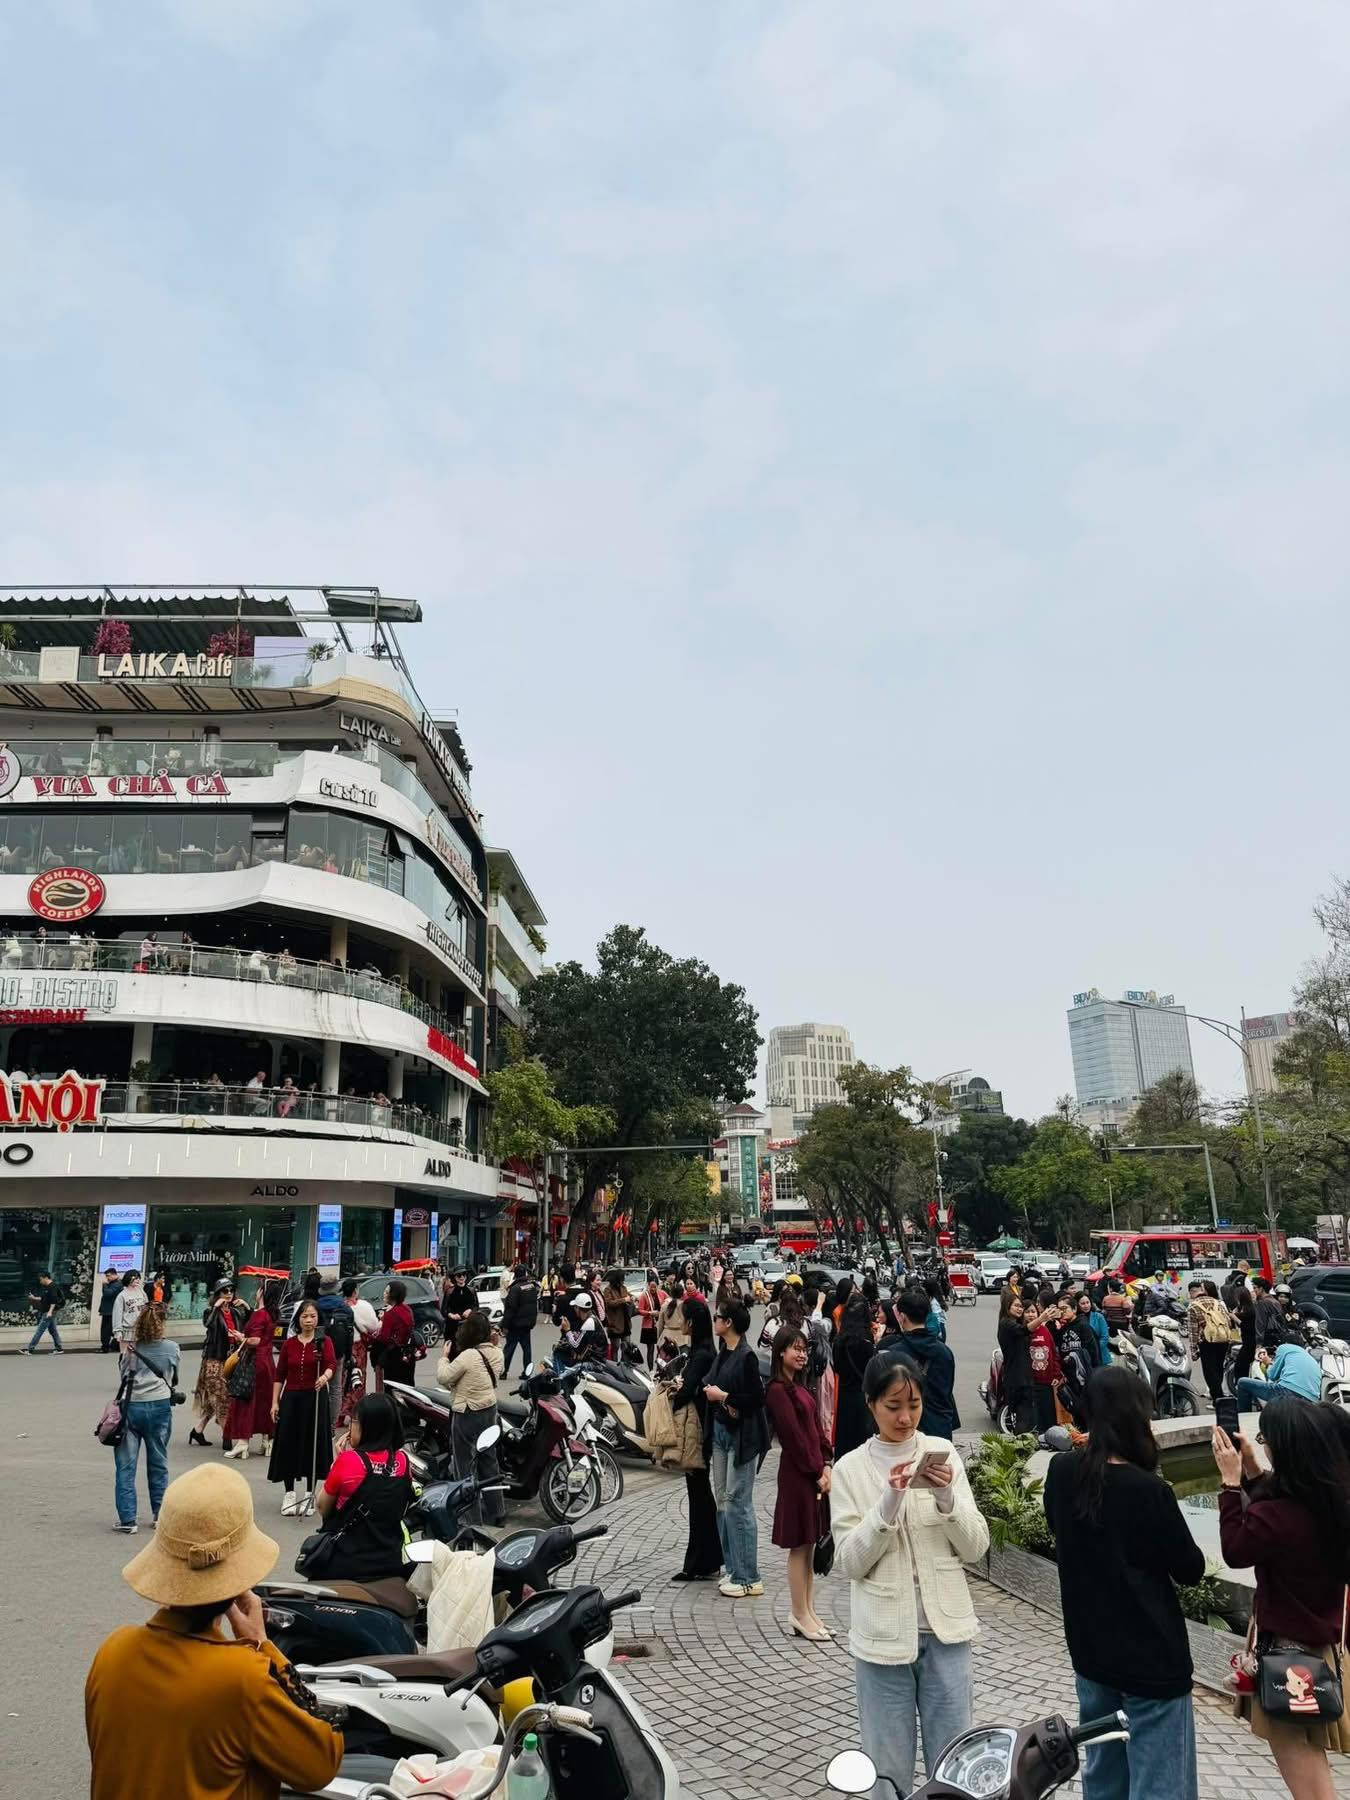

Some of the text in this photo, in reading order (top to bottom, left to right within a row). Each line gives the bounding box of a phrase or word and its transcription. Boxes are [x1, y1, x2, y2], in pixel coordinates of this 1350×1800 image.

[98, 652, 233, 677] LAIKA Café
[338, 711, 389, 743] LAIKA
[31, 768, 231, 796] VUA CHẢ CÁ
[362, 788, 379, 808] 10
[33, 870, 101, 893] HIGHLANDS
[39, 904, 91, 919] COFFEE
[30, 977, 118, 1009] BISTRO
[1127, 990, 1148, 1001] BIDV
[0, 1143, 34, 1165] O
[423, 1157, 451, 1178] ALDO
[250, 1184, 299, 1197] ALDO
[314, 1604, 357, 1616] VISION
[379, 1692, 431, 1702] VISION
